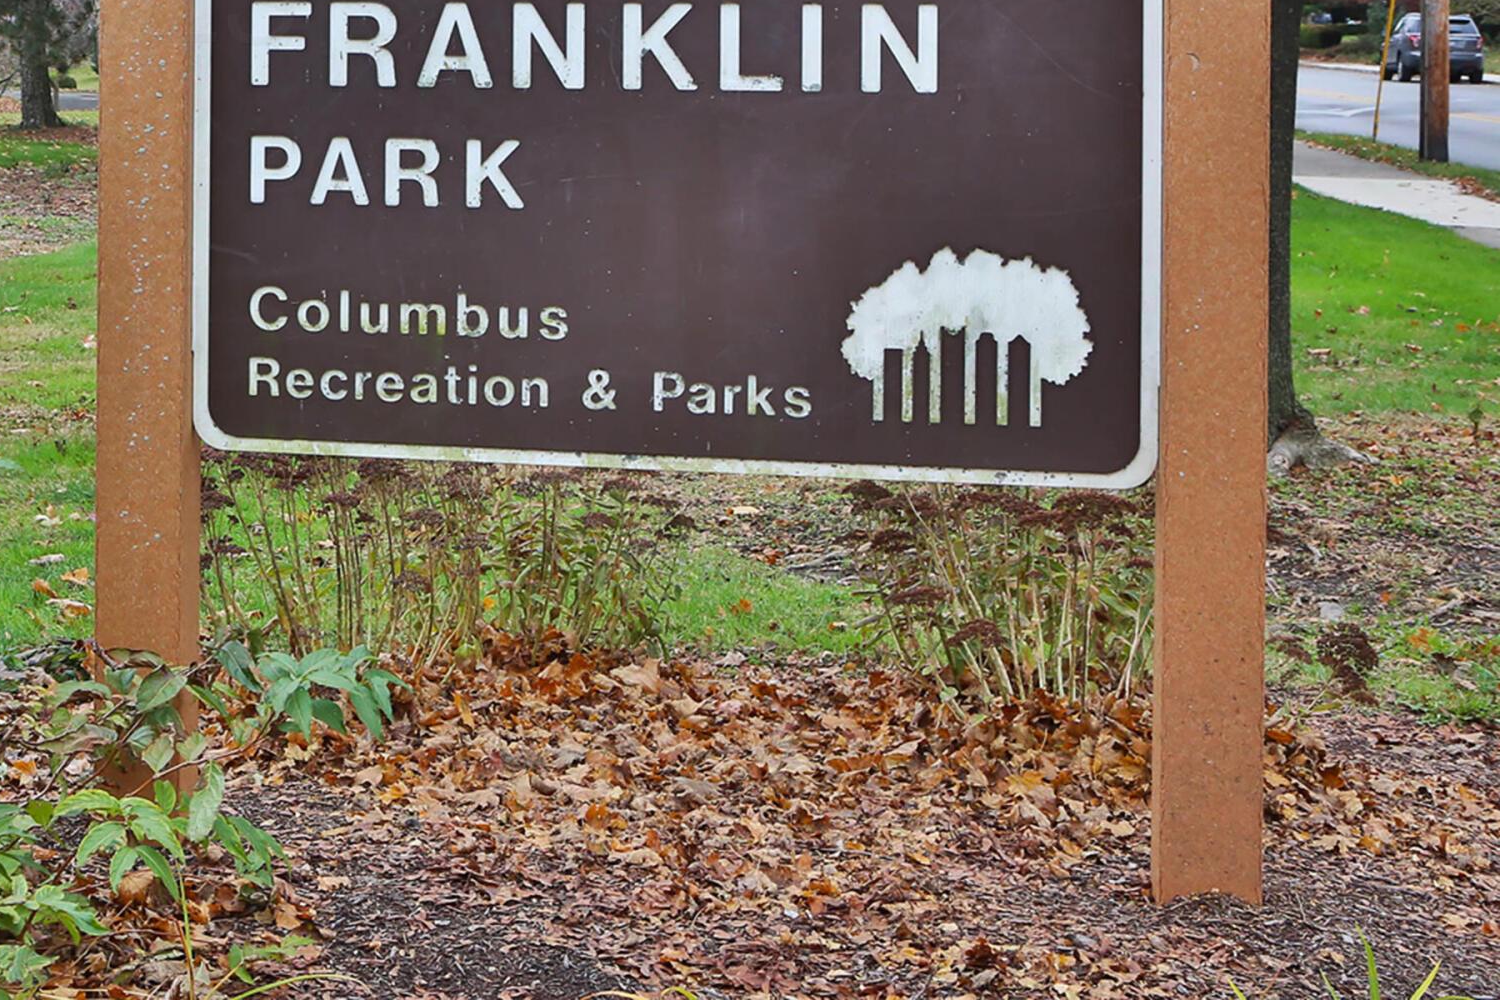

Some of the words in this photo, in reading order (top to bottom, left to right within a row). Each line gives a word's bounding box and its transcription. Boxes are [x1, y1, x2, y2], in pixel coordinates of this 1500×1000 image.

[249, 0, 940, 95] FRANKLIN
[249, 134, 525, 210] PARK
[248, 285, 570, 341] Columbus
[246, 355, 551, 409] Recreation
[581, 369, 617, 412] &
[650, 370, 814, 419] Parks
